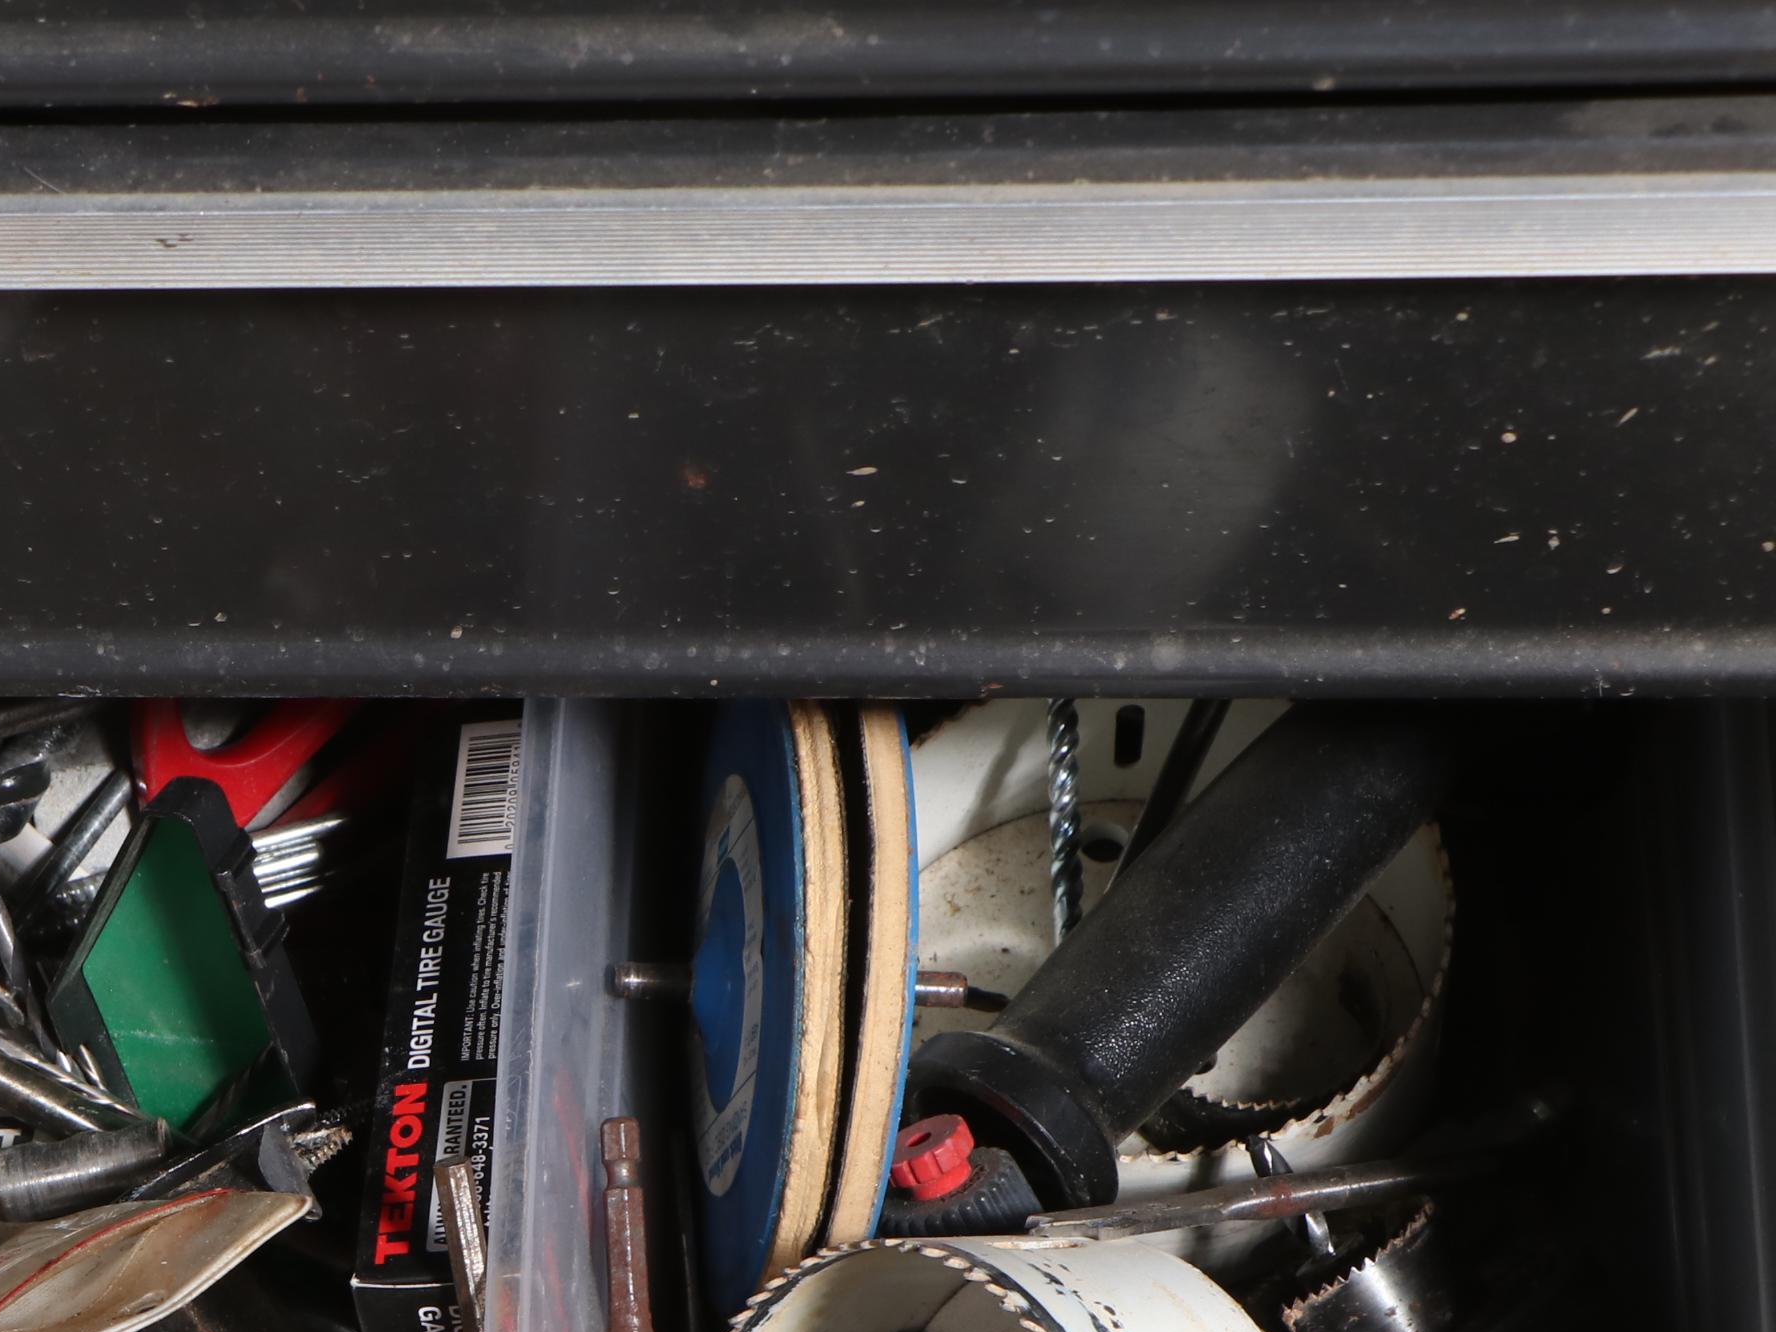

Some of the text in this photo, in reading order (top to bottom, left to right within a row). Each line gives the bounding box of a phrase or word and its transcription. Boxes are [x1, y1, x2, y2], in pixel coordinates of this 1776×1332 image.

[478, 884, 488, 906] Check
[489, 870, 502, 916] recommended
[472, 923, 486, 952] inflating
[470, 952, 480, 972] when
[467, 972, 479, 998] caution
[479, 987, 489, 1010] Inflate
[467, 998, 476, 1013] Use
[477, 1010, 487, 1031] often.
[461, 1013, 474, 1061] IMPORTANT:
[475, 1031, 485, 1060] pressure
[487, 1028, 498, 1059] pressure
[375, 877, 451, 1264] TEKTON DIGITAL TIRE GAUGE
